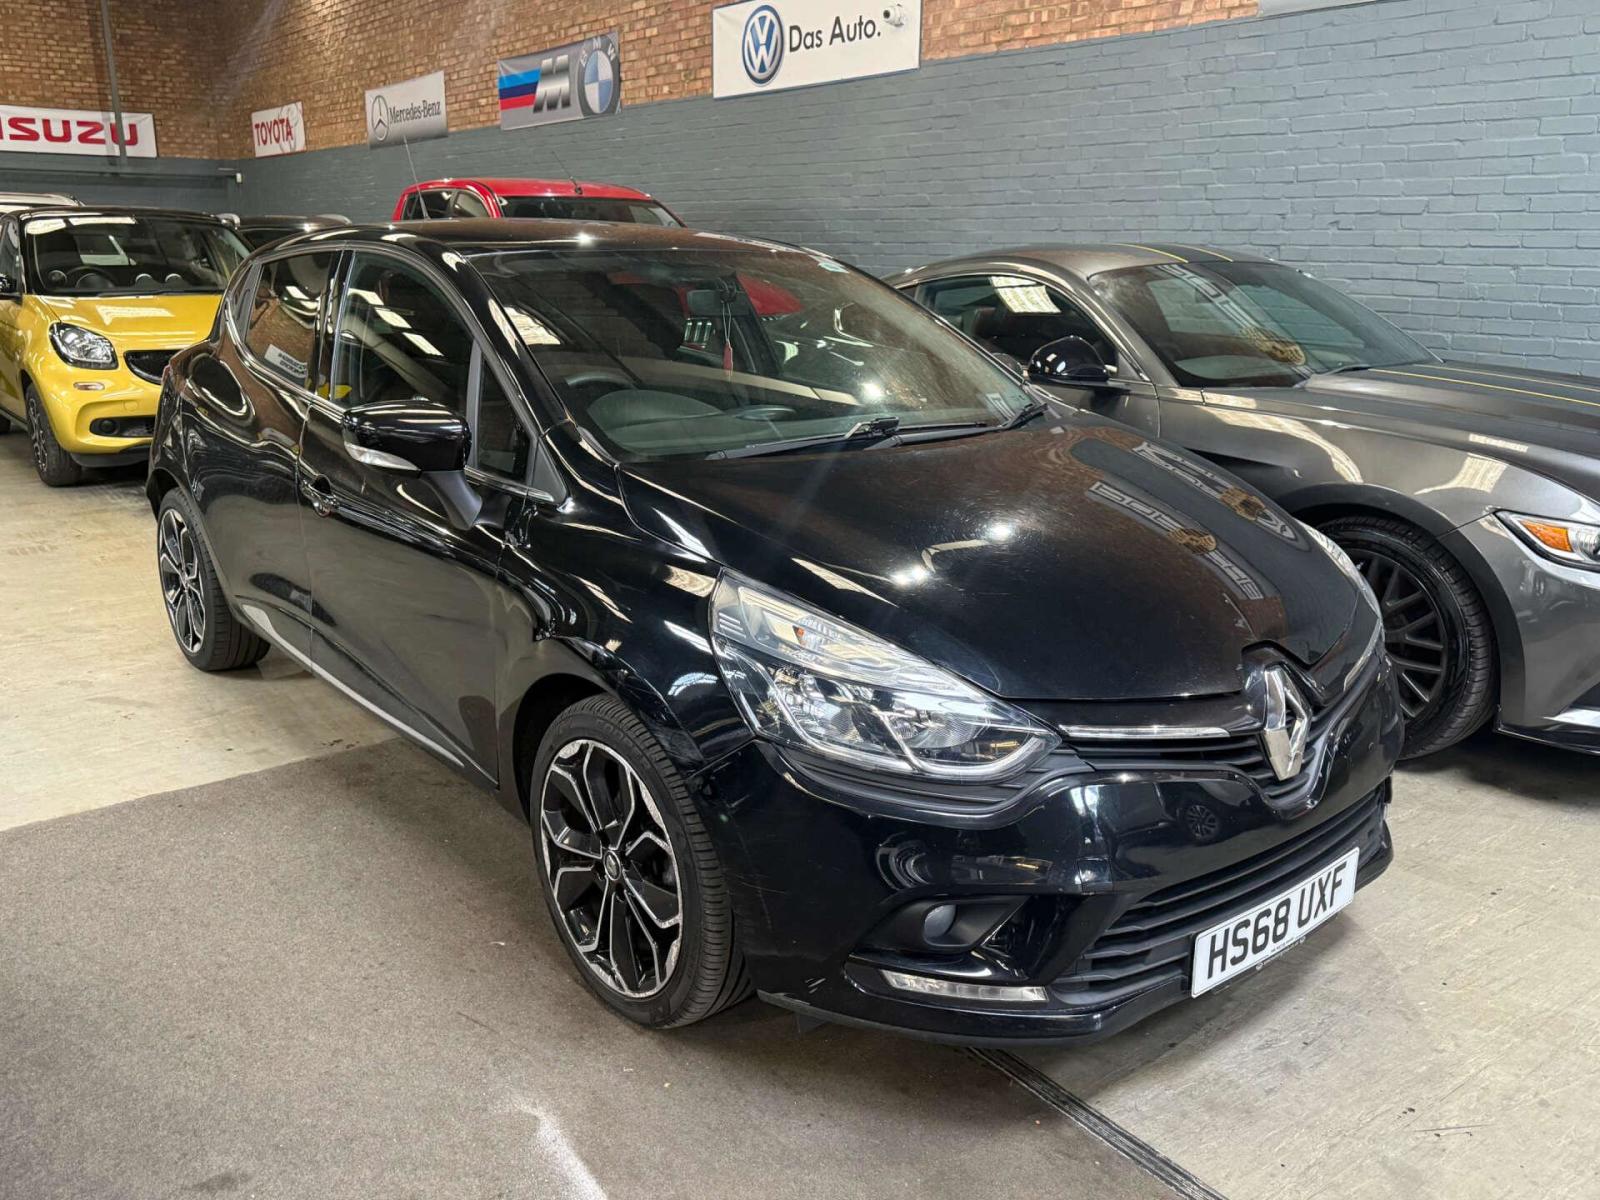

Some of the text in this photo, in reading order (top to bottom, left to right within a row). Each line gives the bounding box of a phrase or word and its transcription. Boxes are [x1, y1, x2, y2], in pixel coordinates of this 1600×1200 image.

[789, 15, 881, 53] Das Auto.
[388, 99, 441, 124] Mercedes-Benz
[254, 117, 294, 146] TOYOTA
[1207, 897, 1292, 980] HS68
[1297, 860, 1348, 929] UXF
